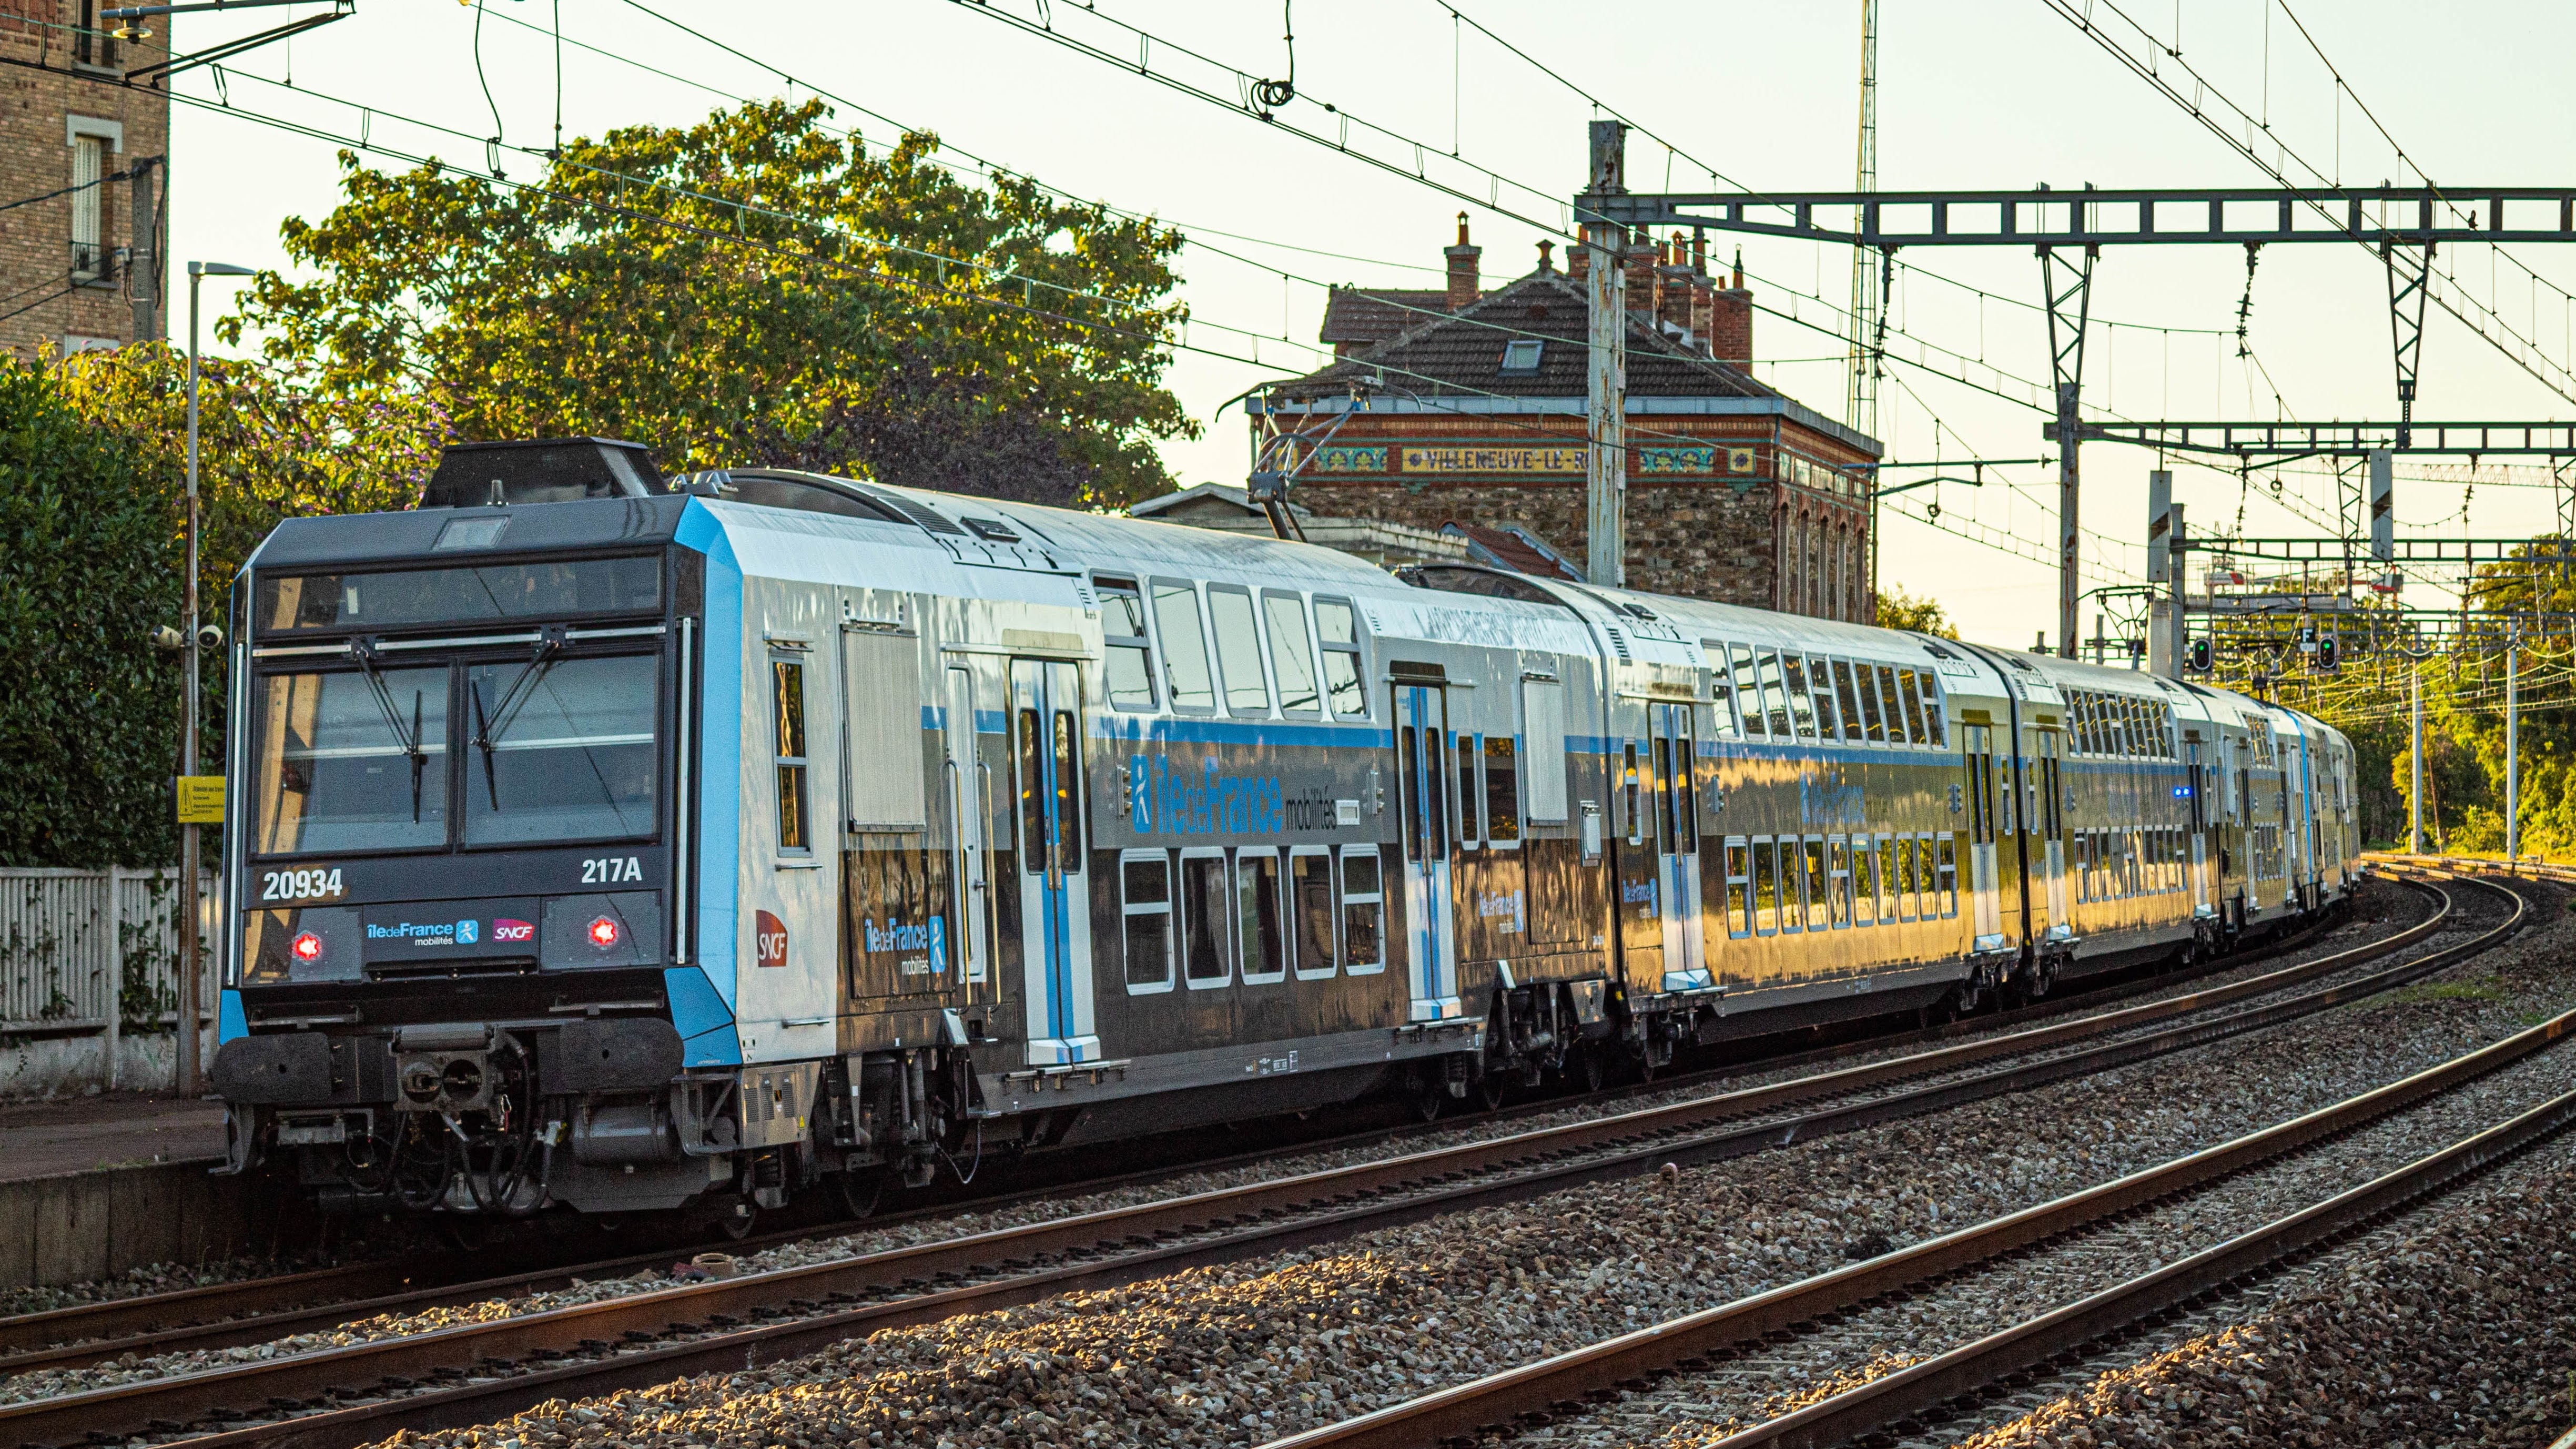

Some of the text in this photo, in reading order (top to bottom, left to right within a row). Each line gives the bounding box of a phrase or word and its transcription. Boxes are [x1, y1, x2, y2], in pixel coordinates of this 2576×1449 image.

[1427, 450, 1589, 469] VILLENEUVE-LE-R
[2303, 629, 2313, 642] F
[1285, 786, 1336, 831] mobilités
[581, 856, 642, 883] 217A
[263, 868, 342, 900] 20934
[414, 936, 453, 946] mobilités
[494, 926, 533, 939] SNCF
[759, 933, 786, 960] SNCF
[901, 954, 929, 976] mobilités
